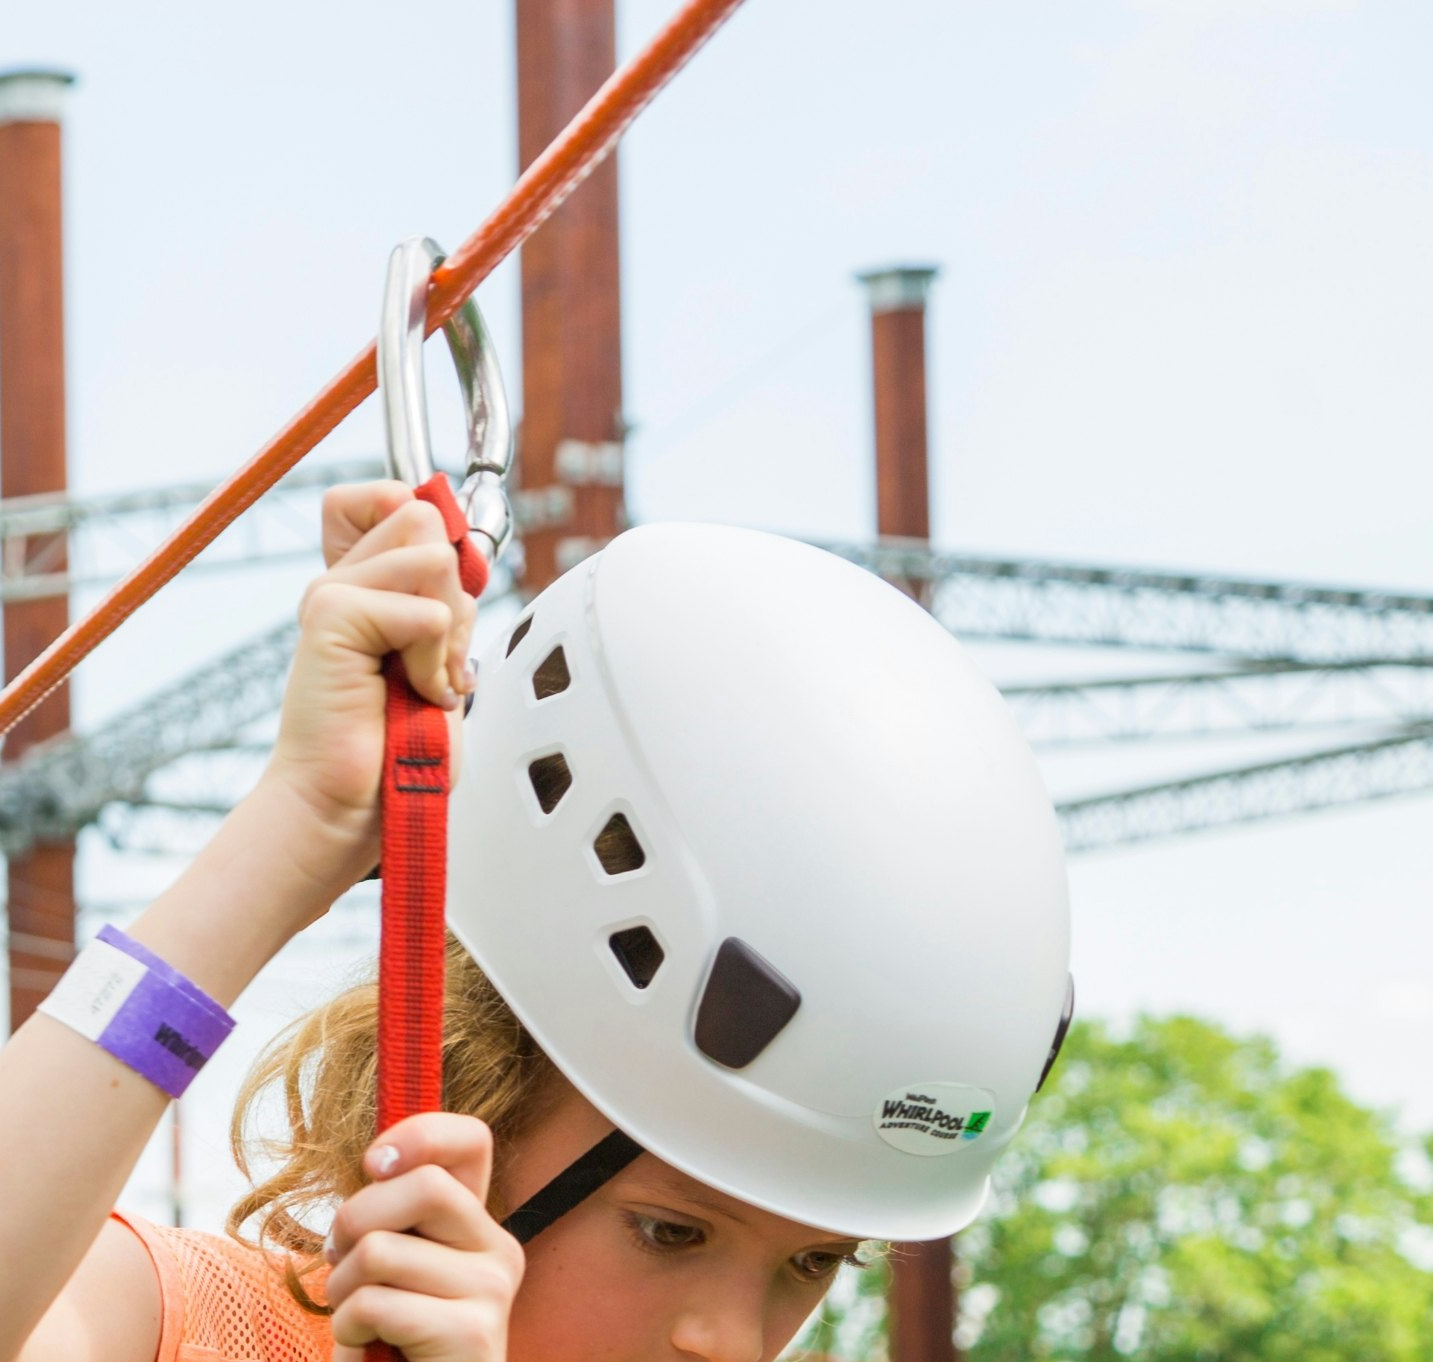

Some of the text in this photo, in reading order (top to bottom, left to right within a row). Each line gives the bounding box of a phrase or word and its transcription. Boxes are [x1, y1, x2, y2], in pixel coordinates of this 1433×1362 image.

[882, 1099, 964, 1131] WHIRLPOOL
[880, 1121, 959, 1139] ADVENTURE COURSE
